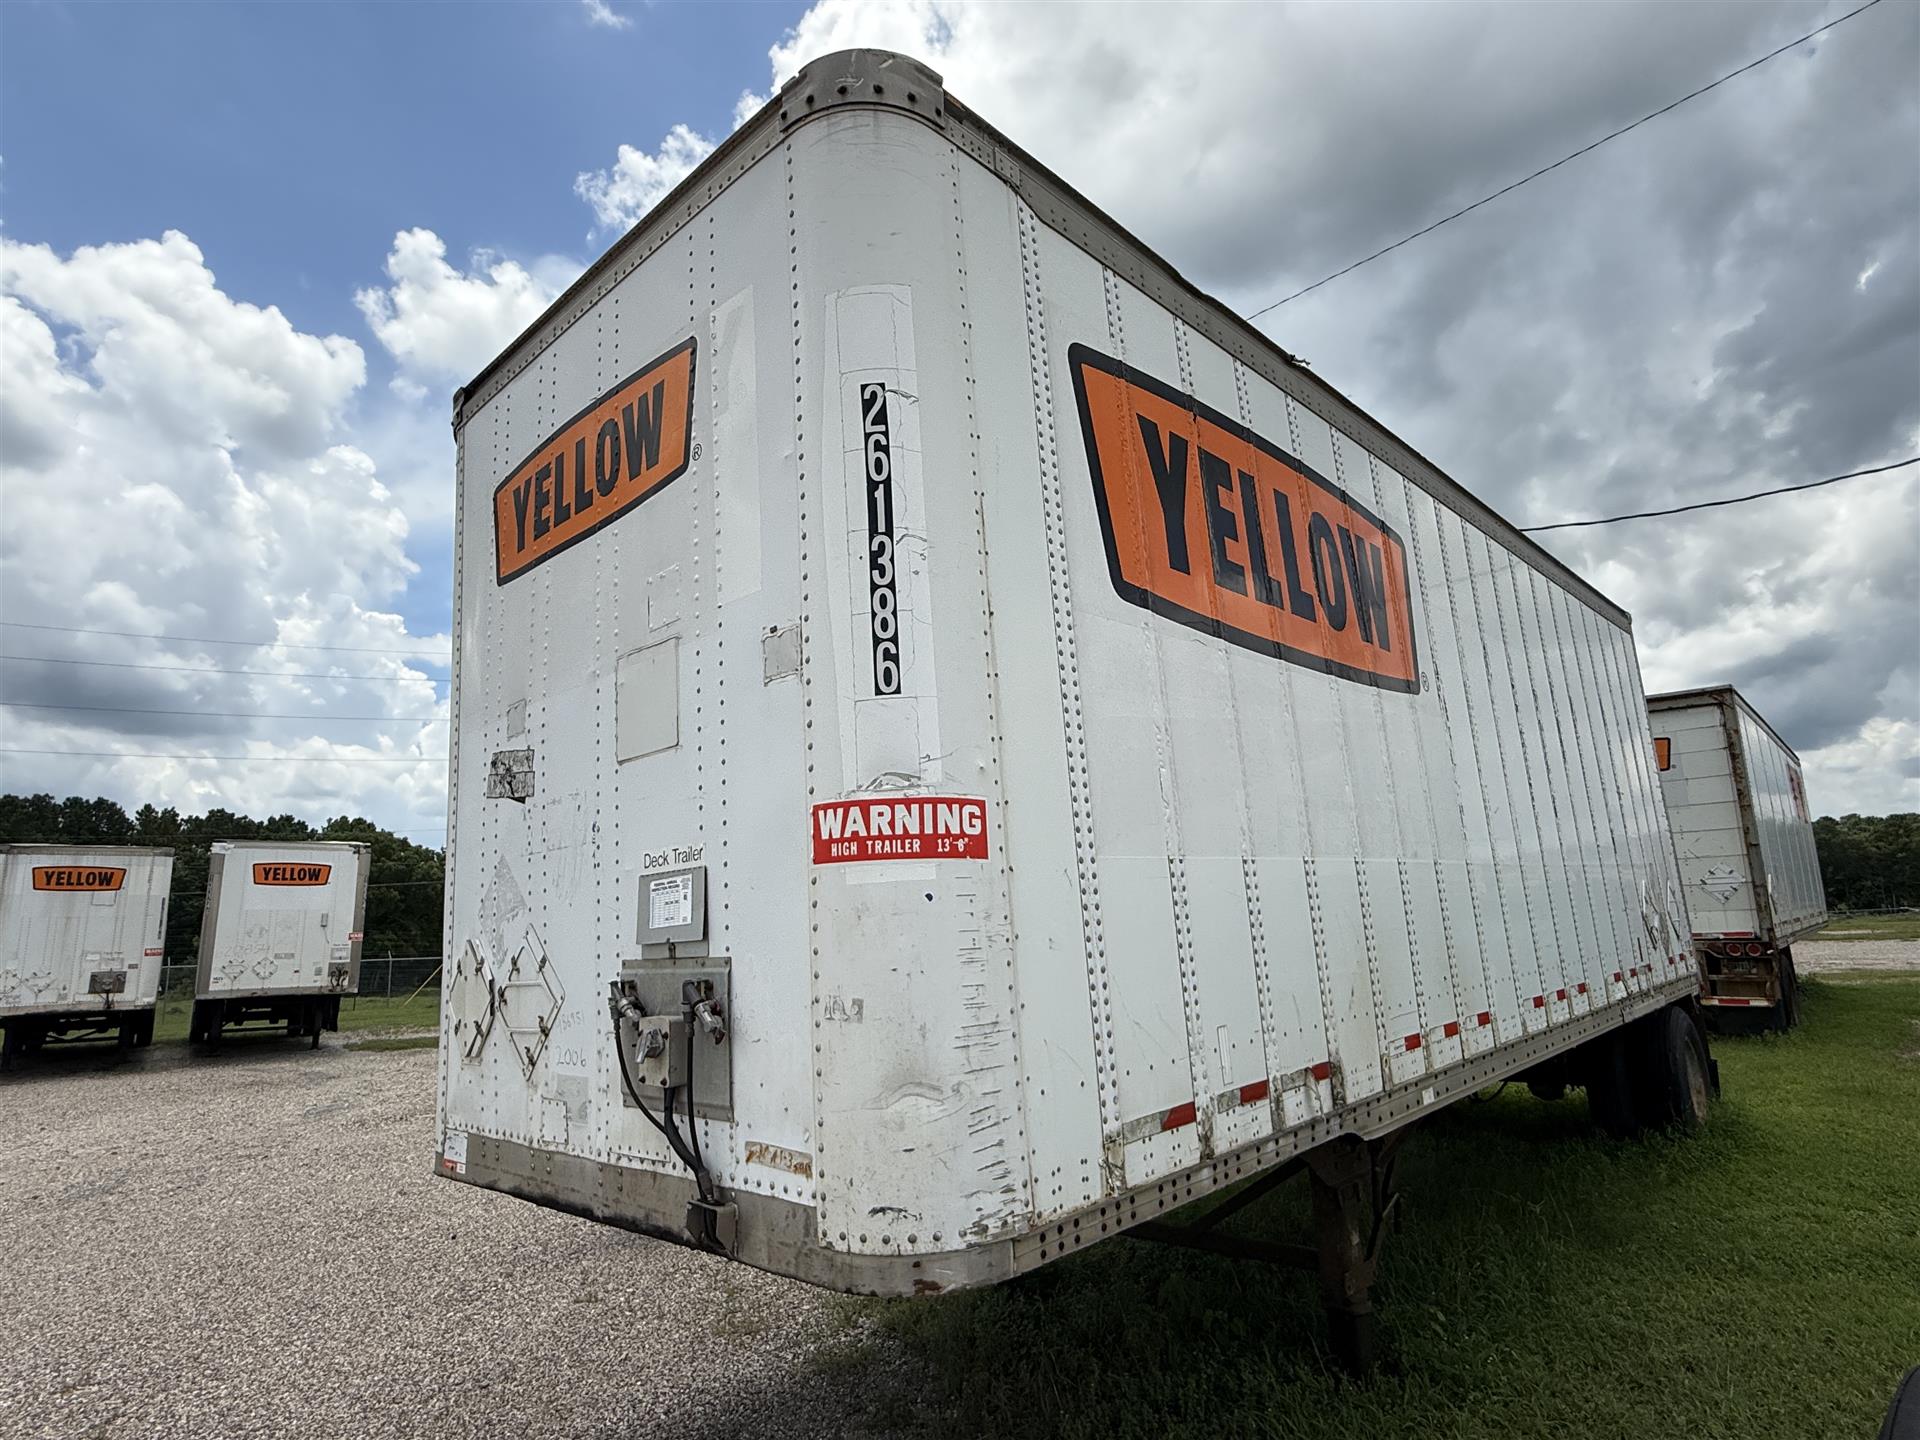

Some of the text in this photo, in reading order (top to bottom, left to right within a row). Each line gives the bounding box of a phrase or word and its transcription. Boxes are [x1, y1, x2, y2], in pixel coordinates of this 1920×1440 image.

[512, 379, 665, 554] YELLOW
[863, 383, 900, 694] 261386
[1135, 412, 1391, 652] YELLOW
[818, 803, 982, 840] WARNING
[643, 845, 703, 869] Deck Trailer
[831, 841, 858, 857] HIGH
[866, 838, 921, 854] TRAILER
[44, 871, 115, 886] YELLOW
[263, 867, 322, 881] YELLOW
[556, 1045, 587, 1067] 2006
